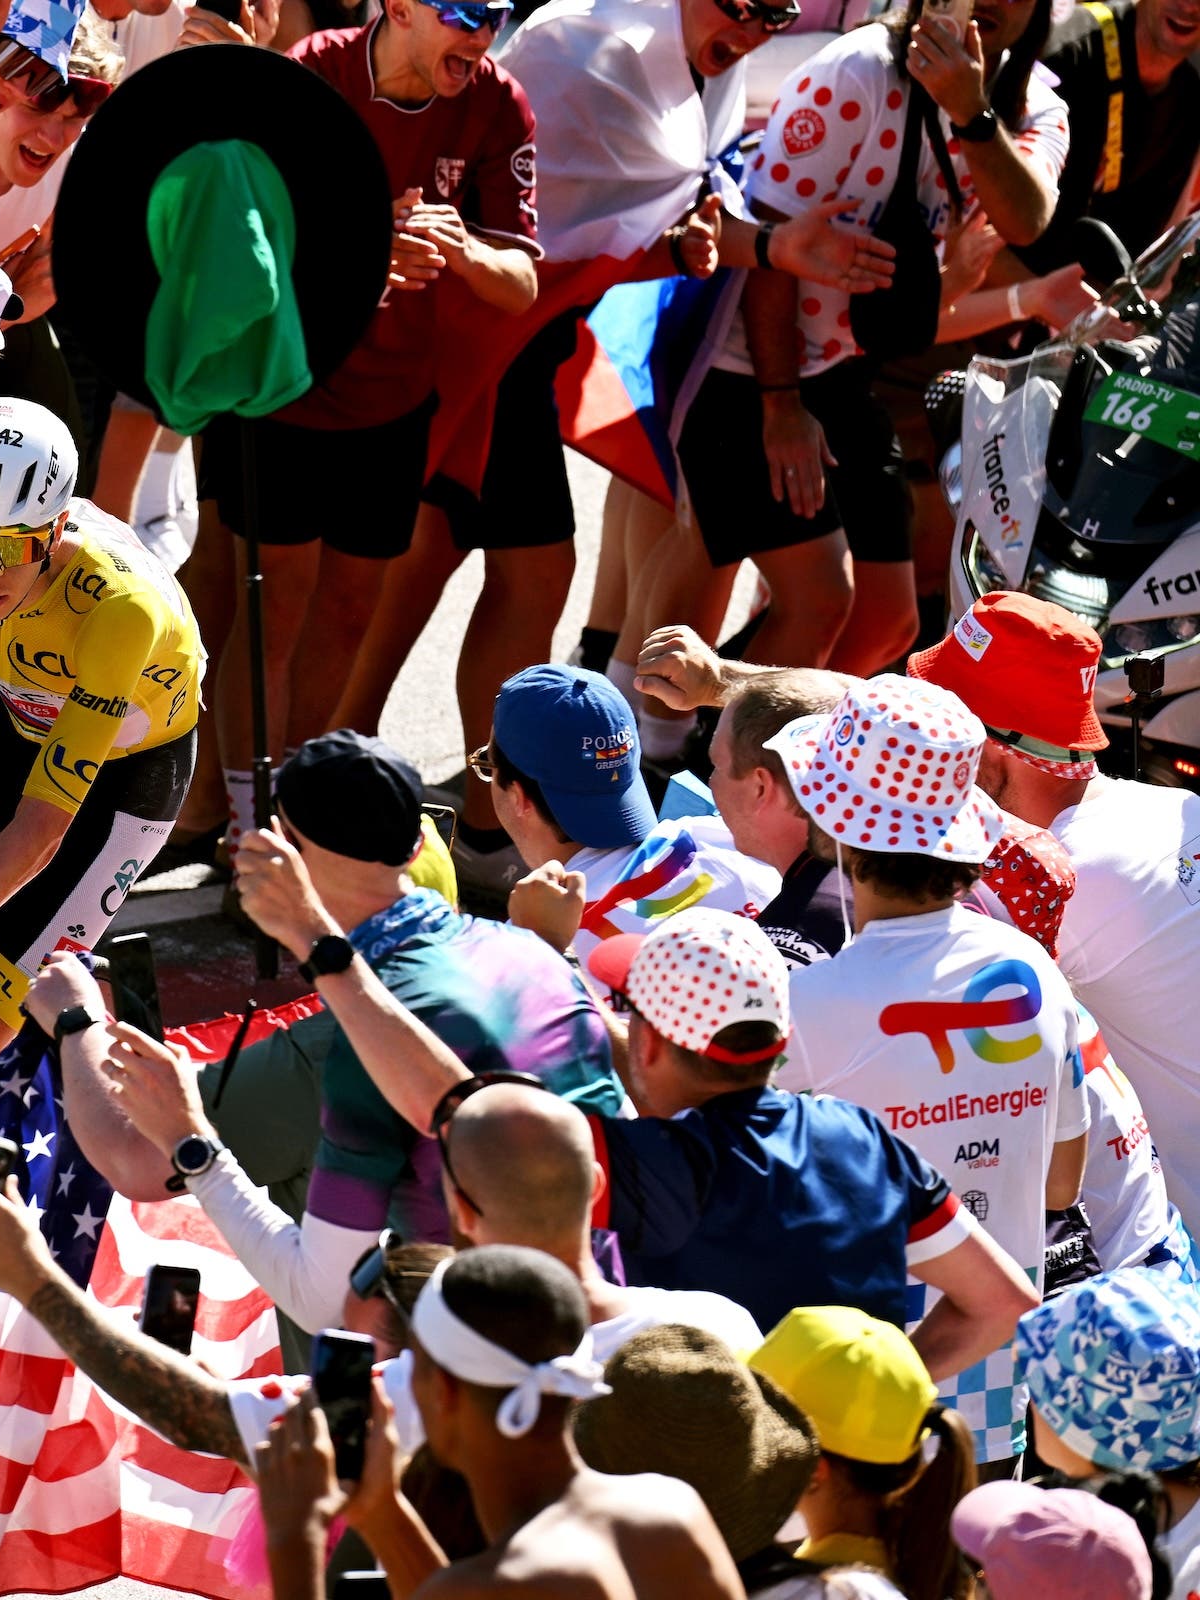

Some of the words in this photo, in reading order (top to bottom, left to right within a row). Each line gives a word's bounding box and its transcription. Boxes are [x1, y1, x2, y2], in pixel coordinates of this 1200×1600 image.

[1114, 376, 1175, 403] RADIO-TV
[1101, 393, 1158, 431] 166
[37, 445, 60, 505] MET
[71, 567, 108, 602] LCL
[15, 642, 77, 679] LCL
[141, 664, 182, 691] LCL
[582, 725, 632, 750] POROS
[595, 756, 629, 770] GREECE
[954, 1138, 999, 1163] ADM
[968, 1156, 999, 1169] value
